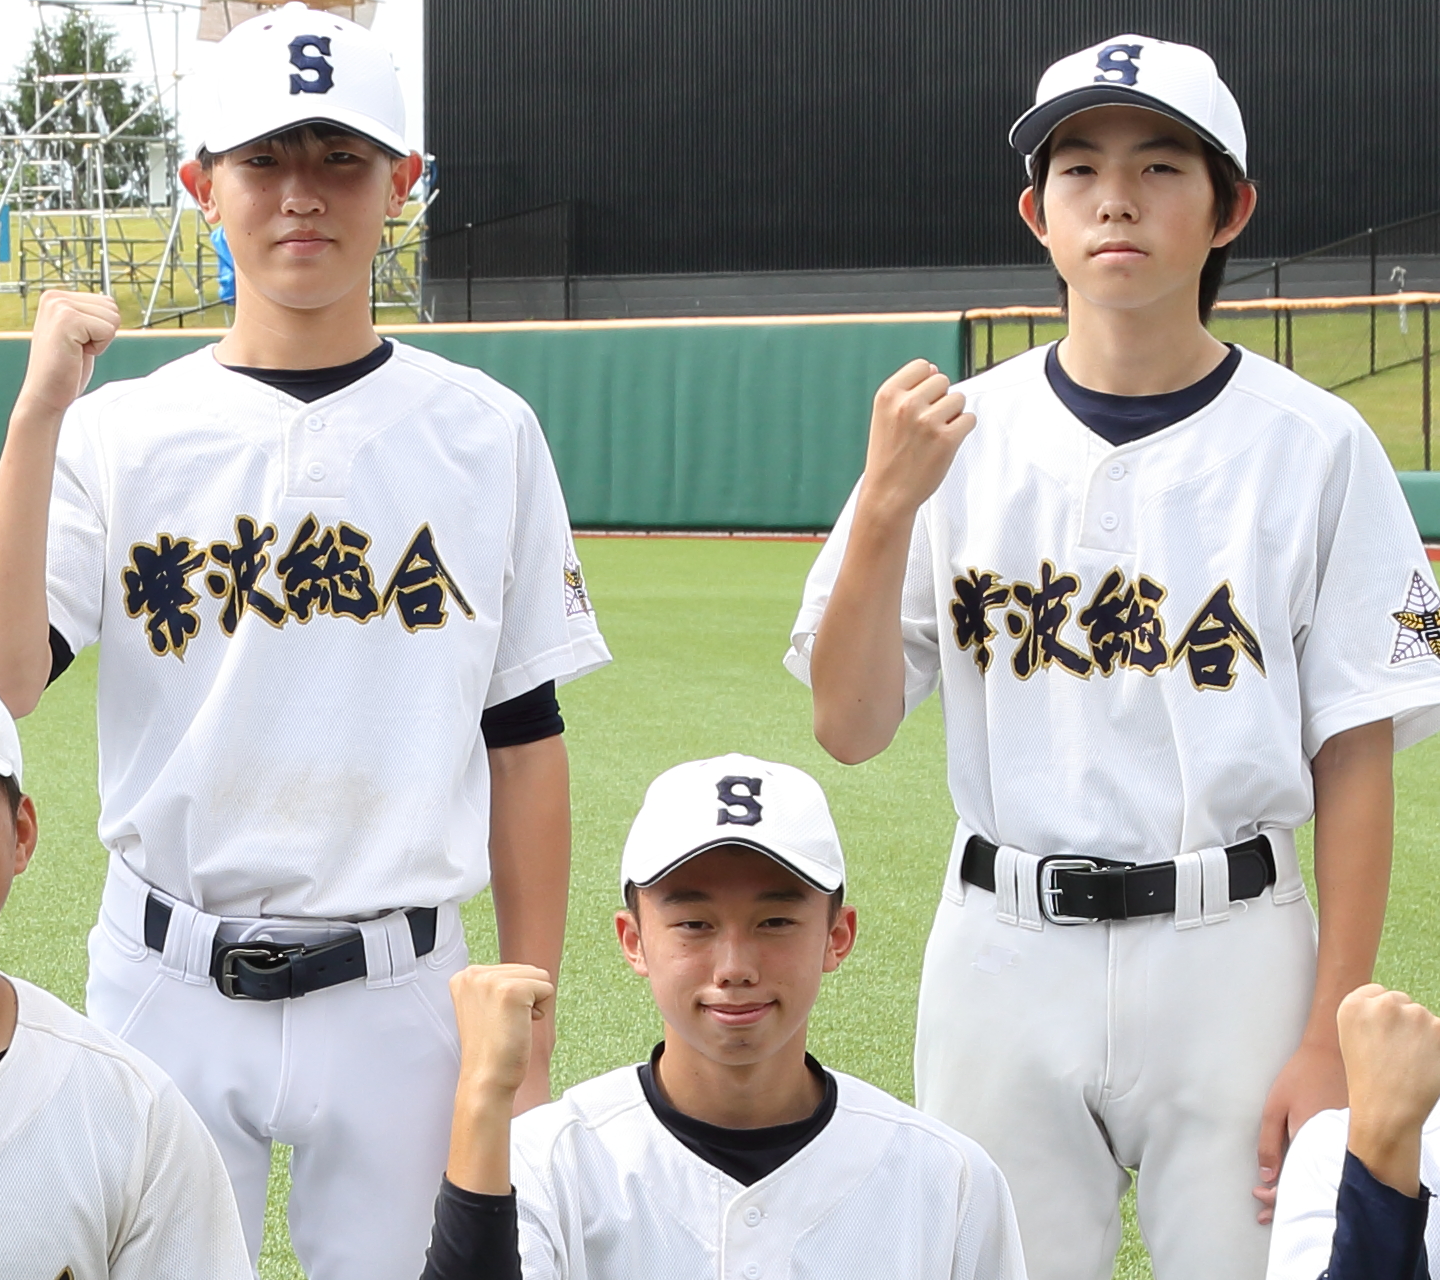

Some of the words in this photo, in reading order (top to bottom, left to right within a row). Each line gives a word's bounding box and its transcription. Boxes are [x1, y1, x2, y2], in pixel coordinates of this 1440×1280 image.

[288, 35, 334, 95] S
[1094, 45, 1144, 86] S
[122, 514, 475, 660] 紫波総合
[716, 776, 763, 826] S
